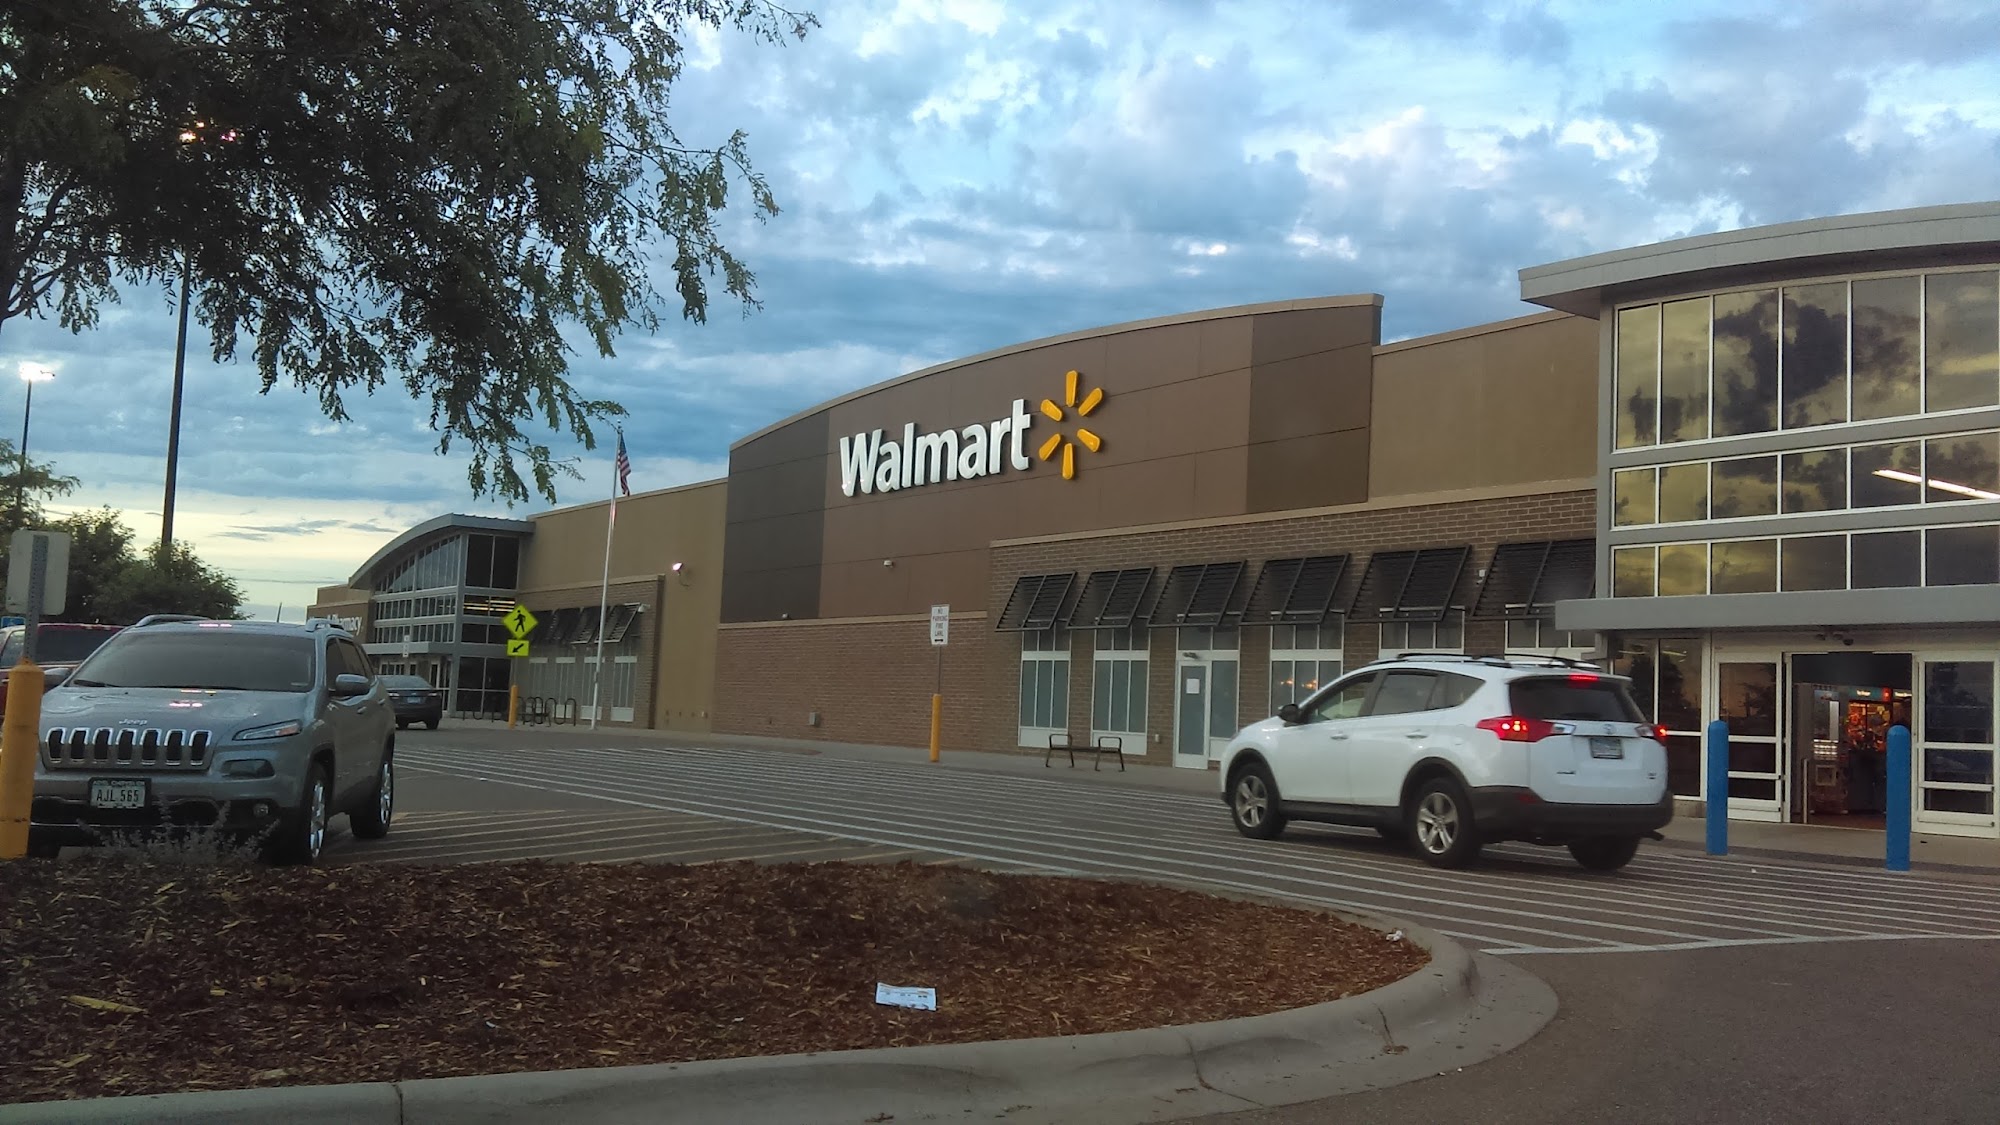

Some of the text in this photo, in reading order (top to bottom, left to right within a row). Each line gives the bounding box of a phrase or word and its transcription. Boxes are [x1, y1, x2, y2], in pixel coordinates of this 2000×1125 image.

[840, 398, 1031, 498] Walmart
[118, 718, 148, 726] Jeep
[96, 789, 139, 802] AJL 565
